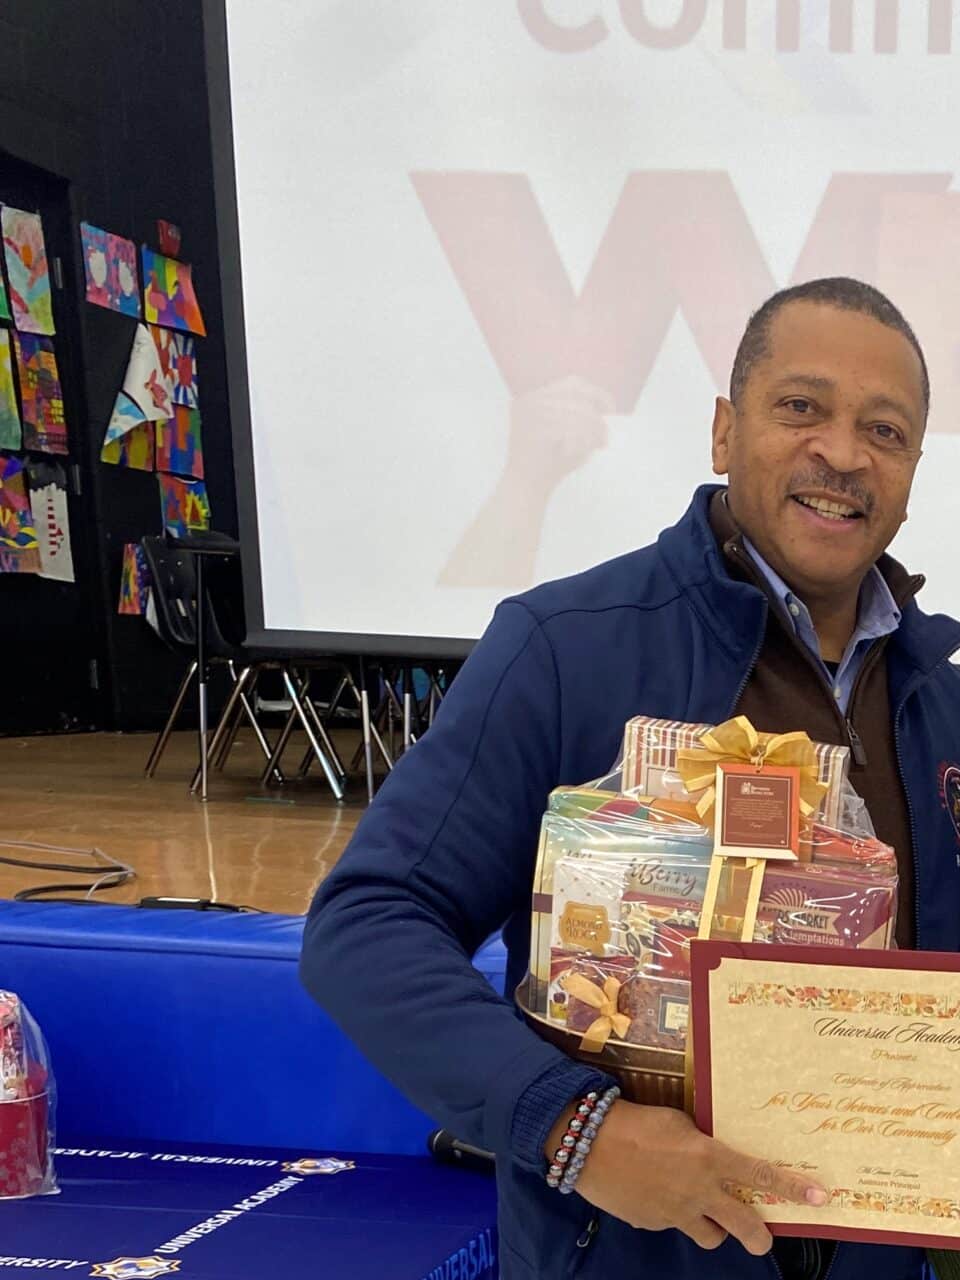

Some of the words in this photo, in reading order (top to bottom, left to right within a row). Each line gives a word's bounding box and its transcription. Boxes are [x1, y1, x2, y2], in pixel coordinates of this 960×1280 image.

[813, 1017, 894, 1041] Universal
[753, 1091, 788, 1110] for
[788, 1091, 832, 1112] Your
[890, 1104, 919, 1118] and
[801, 1116, 840, 1135] for
[840, 1116, 874, 1134] Our
[879, 1119, 957, 1146] Community
[151, 1152, 279, 1167] UNIVERSAL
[153, 1209, 246, 1254] UNIVERSAL
[231, 1176, 304, 1212] ACADEMY
